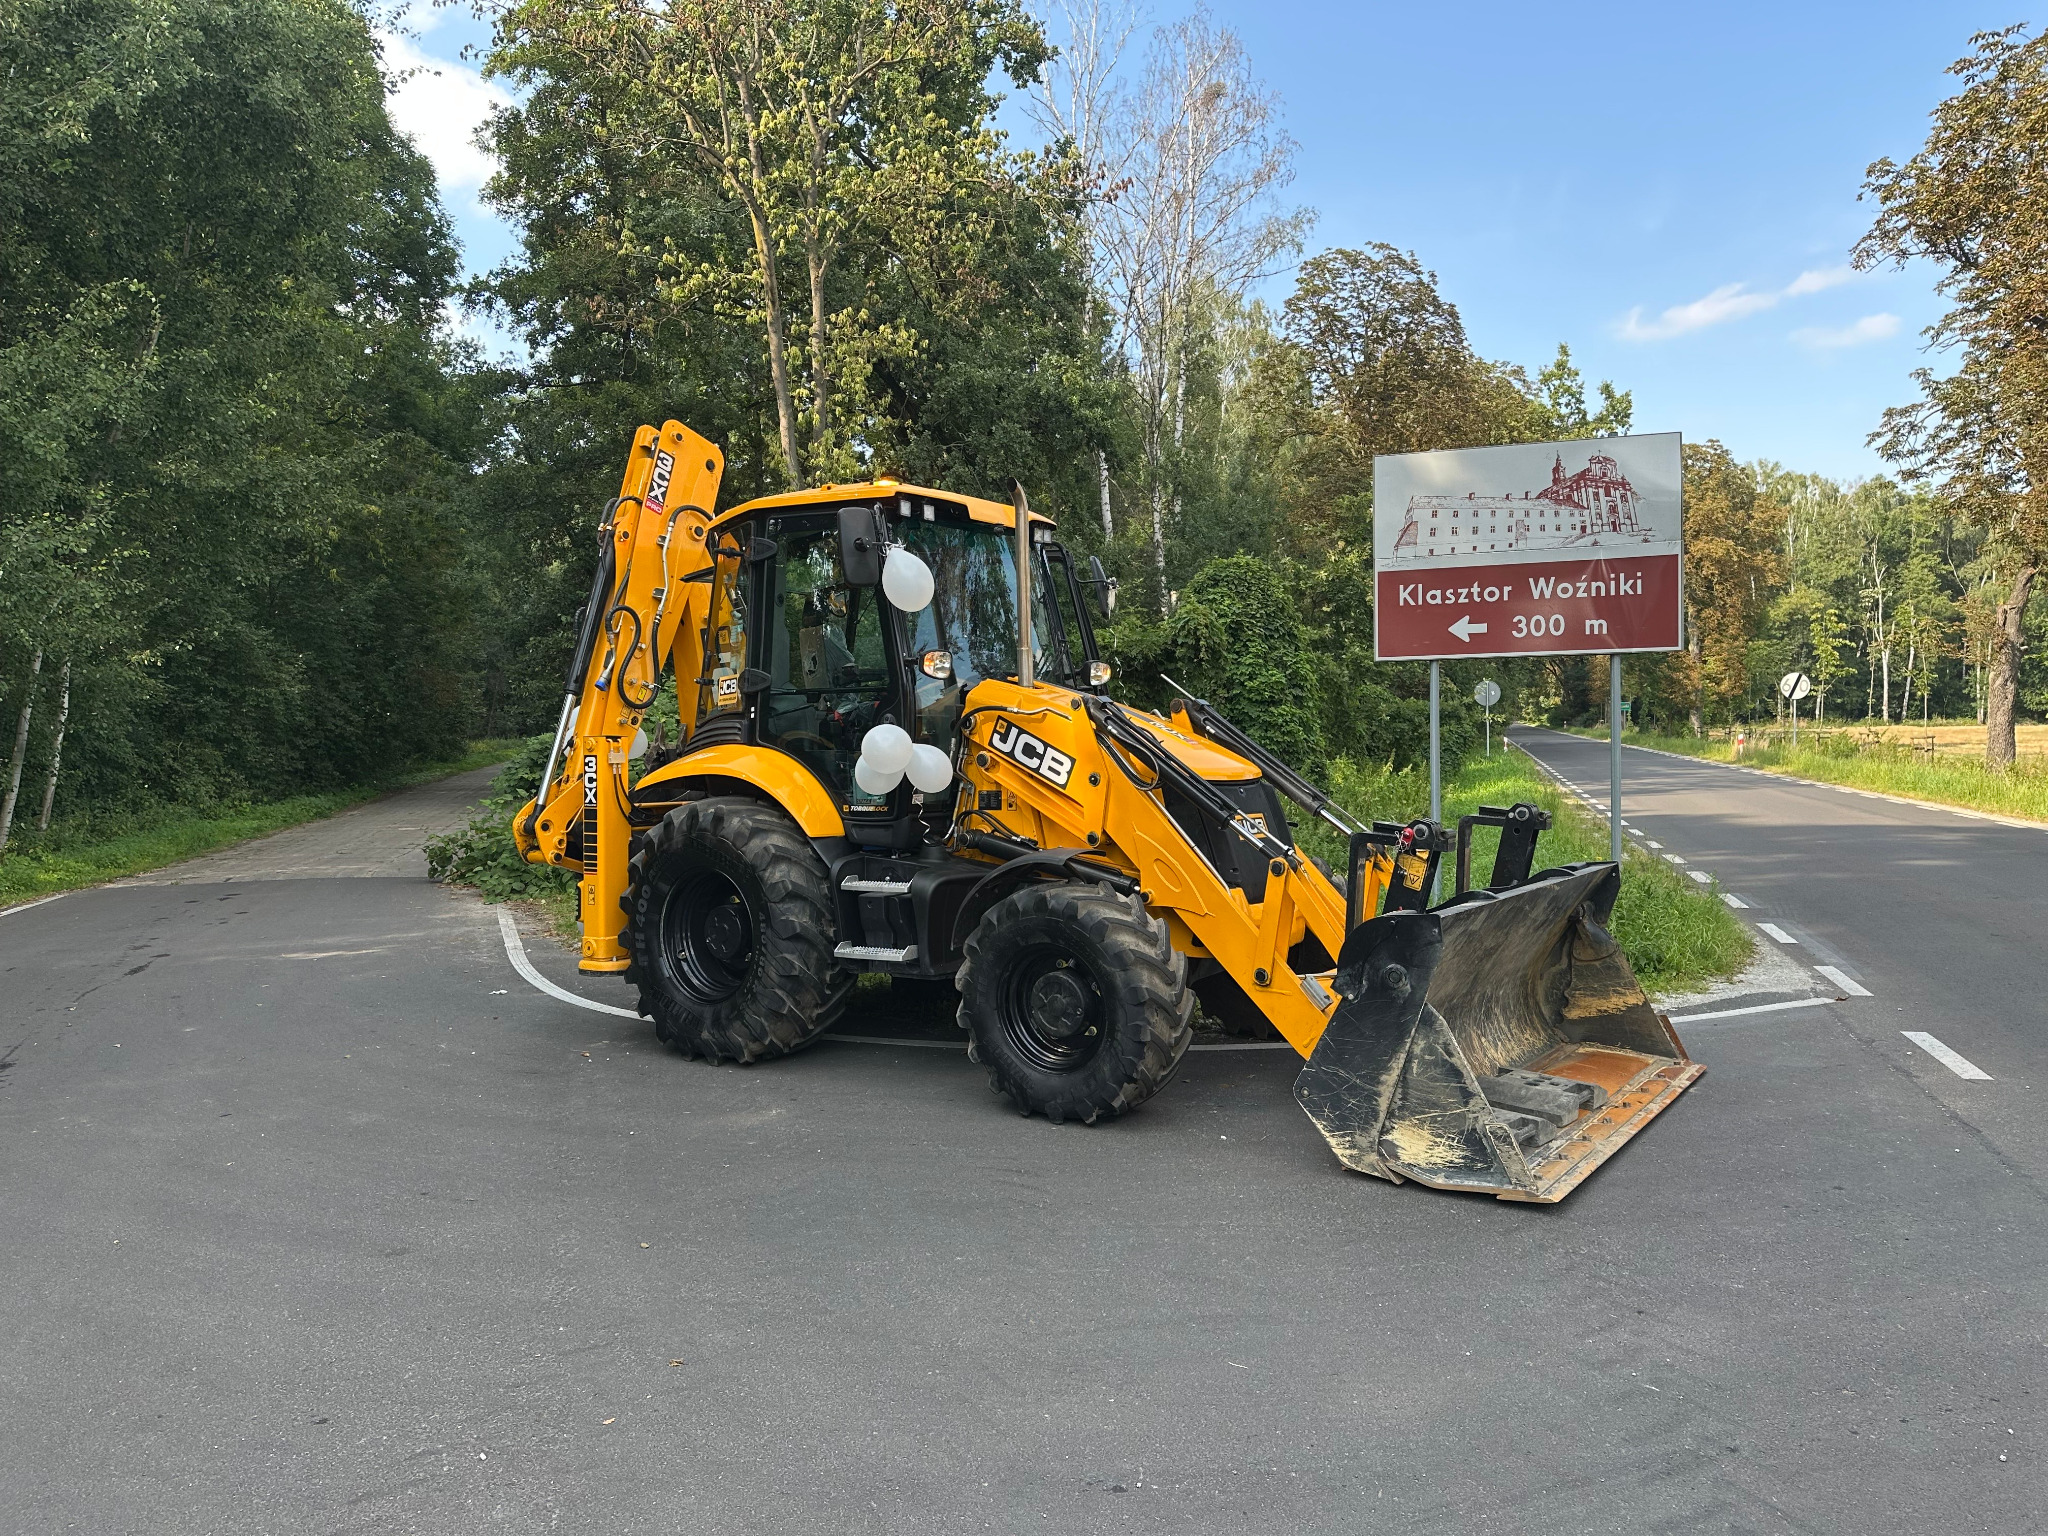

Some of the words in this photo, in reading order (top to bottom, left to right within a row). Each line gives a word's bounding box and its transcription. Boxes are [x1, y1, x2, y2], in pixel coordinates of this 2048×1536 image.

[648, 452, 674, 503] 3CX
[645, 500, 662, 514] PRO
[1399, 581, 1513, 607] Klasztor
[1528, 571, 1643, 600] Woźniki
[1511, 614, 1565, 638] 300
[1585, 618, 1608, 635] m
[720, 679, 737, 695] JCB
[1782, 678, 1809, 692] 60
[992, 726, 1072, 785] JCB
[584, 756, 597, 804] 3CX
[636, 885, 651, 928] 400
